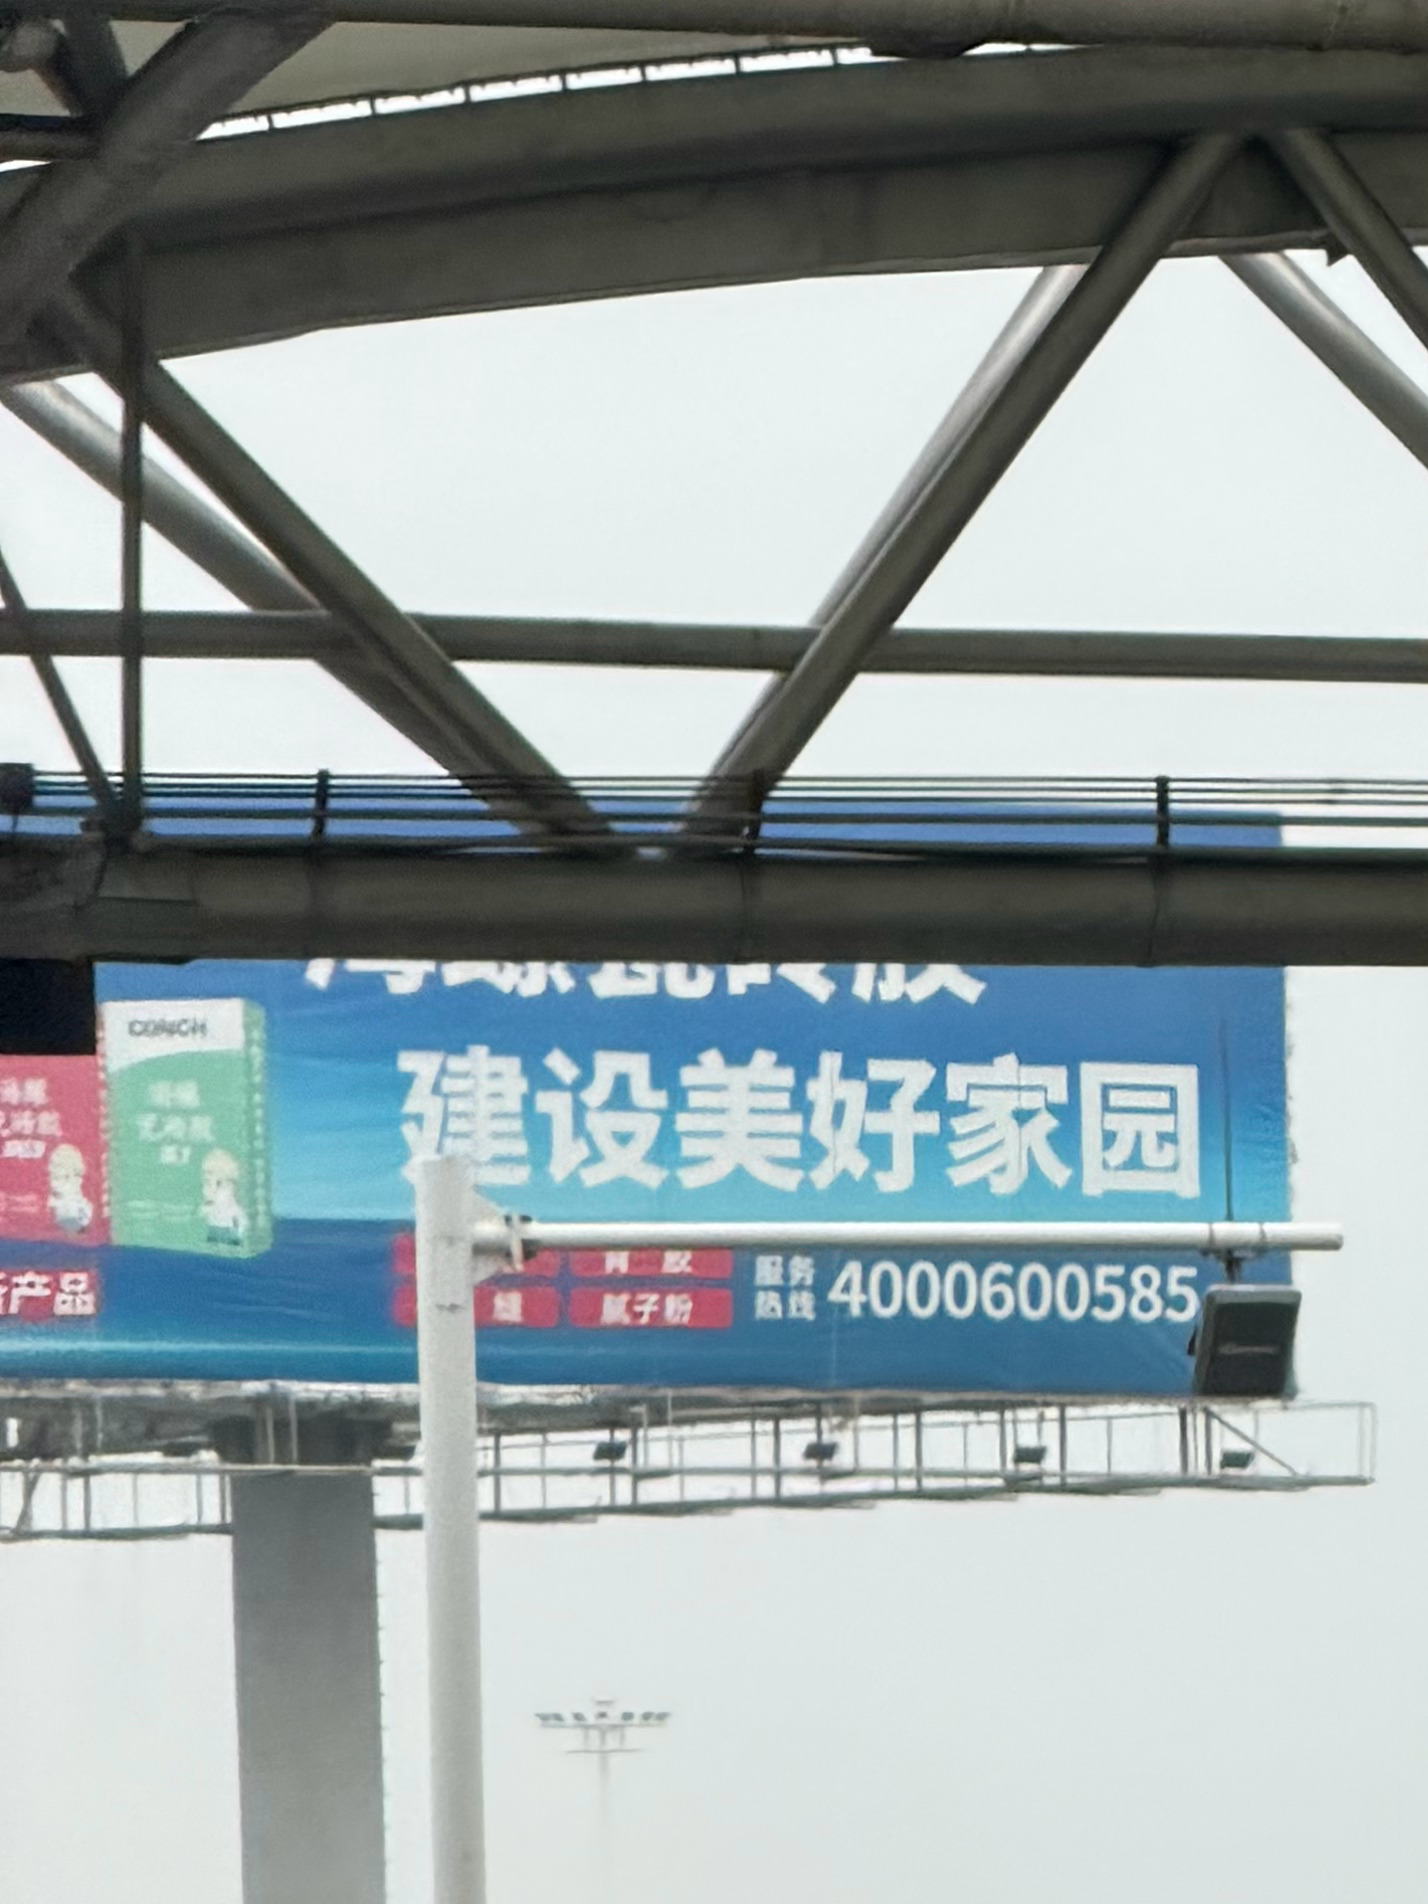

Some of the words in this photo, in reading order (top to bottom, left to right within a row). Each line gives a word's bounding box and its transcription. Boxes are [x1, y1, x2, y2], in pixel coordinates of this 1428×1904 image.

[397, 1045, 1200, 1197] 建设美好家园
[754, 1254, 815, 1286] 服务
[827, 1260, 1200, 1322] 4000600585
[754, 1290, 817, 1321] 热线
